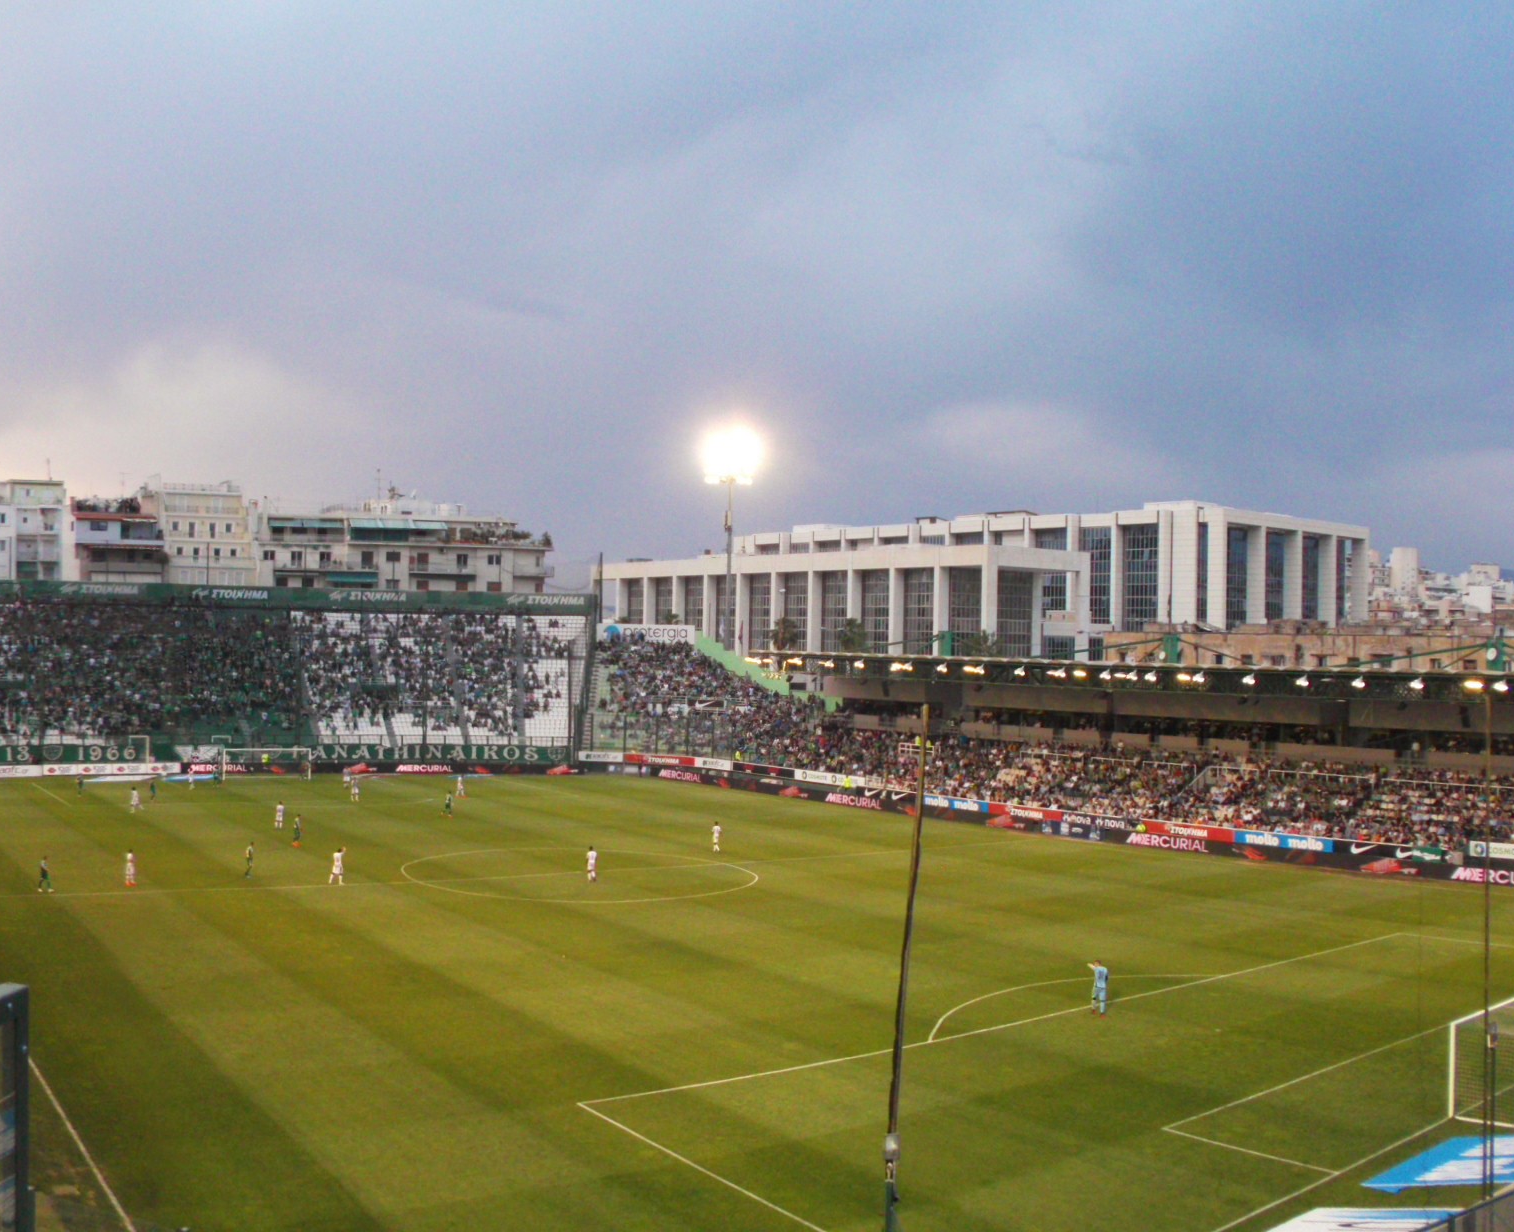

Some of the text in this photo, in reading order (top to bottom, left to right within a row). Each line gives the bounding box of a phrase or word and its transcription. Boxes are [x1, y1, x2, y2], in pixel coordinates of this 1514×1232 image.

[211, 589, 268, 600] ΣΤΟΙΧΗΜΑ
[526, 595, 585, 606] ΣΤΟΙΧΗΜΑ
[6, 745, 29, 761] 13
[78, 745, 136, 761] 1966
[395, 764, 453, 773] MERCURIAL
[658, 768, 702, 783] MERCURIAL
[825, 792, 882, 810] MERCURIAL
[1104, 818, 1125, 829] nova
[1126, 832, 1209, 853] MERCURIAL
